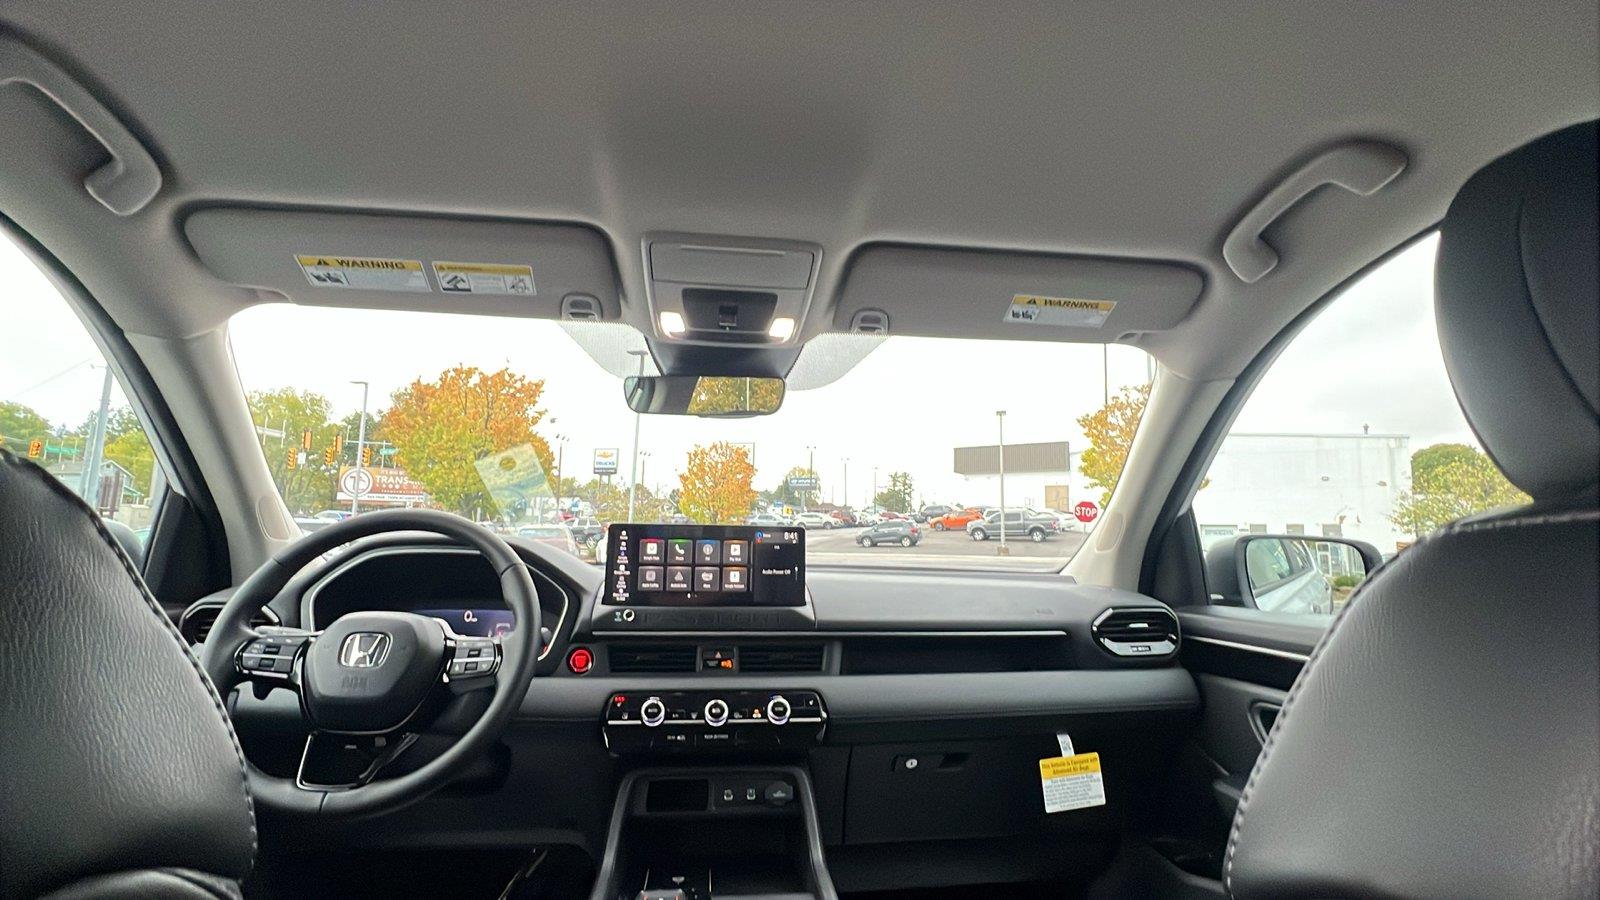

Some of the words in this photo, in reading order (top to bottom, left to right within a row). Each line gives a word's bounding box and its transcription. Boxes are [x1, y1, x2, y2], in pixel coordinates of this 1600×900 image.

[336, 258, 406, 270] WARNING
[1044, 298, 1100, 310] WARNING
[1075, 506, 1097, 517] STOP
